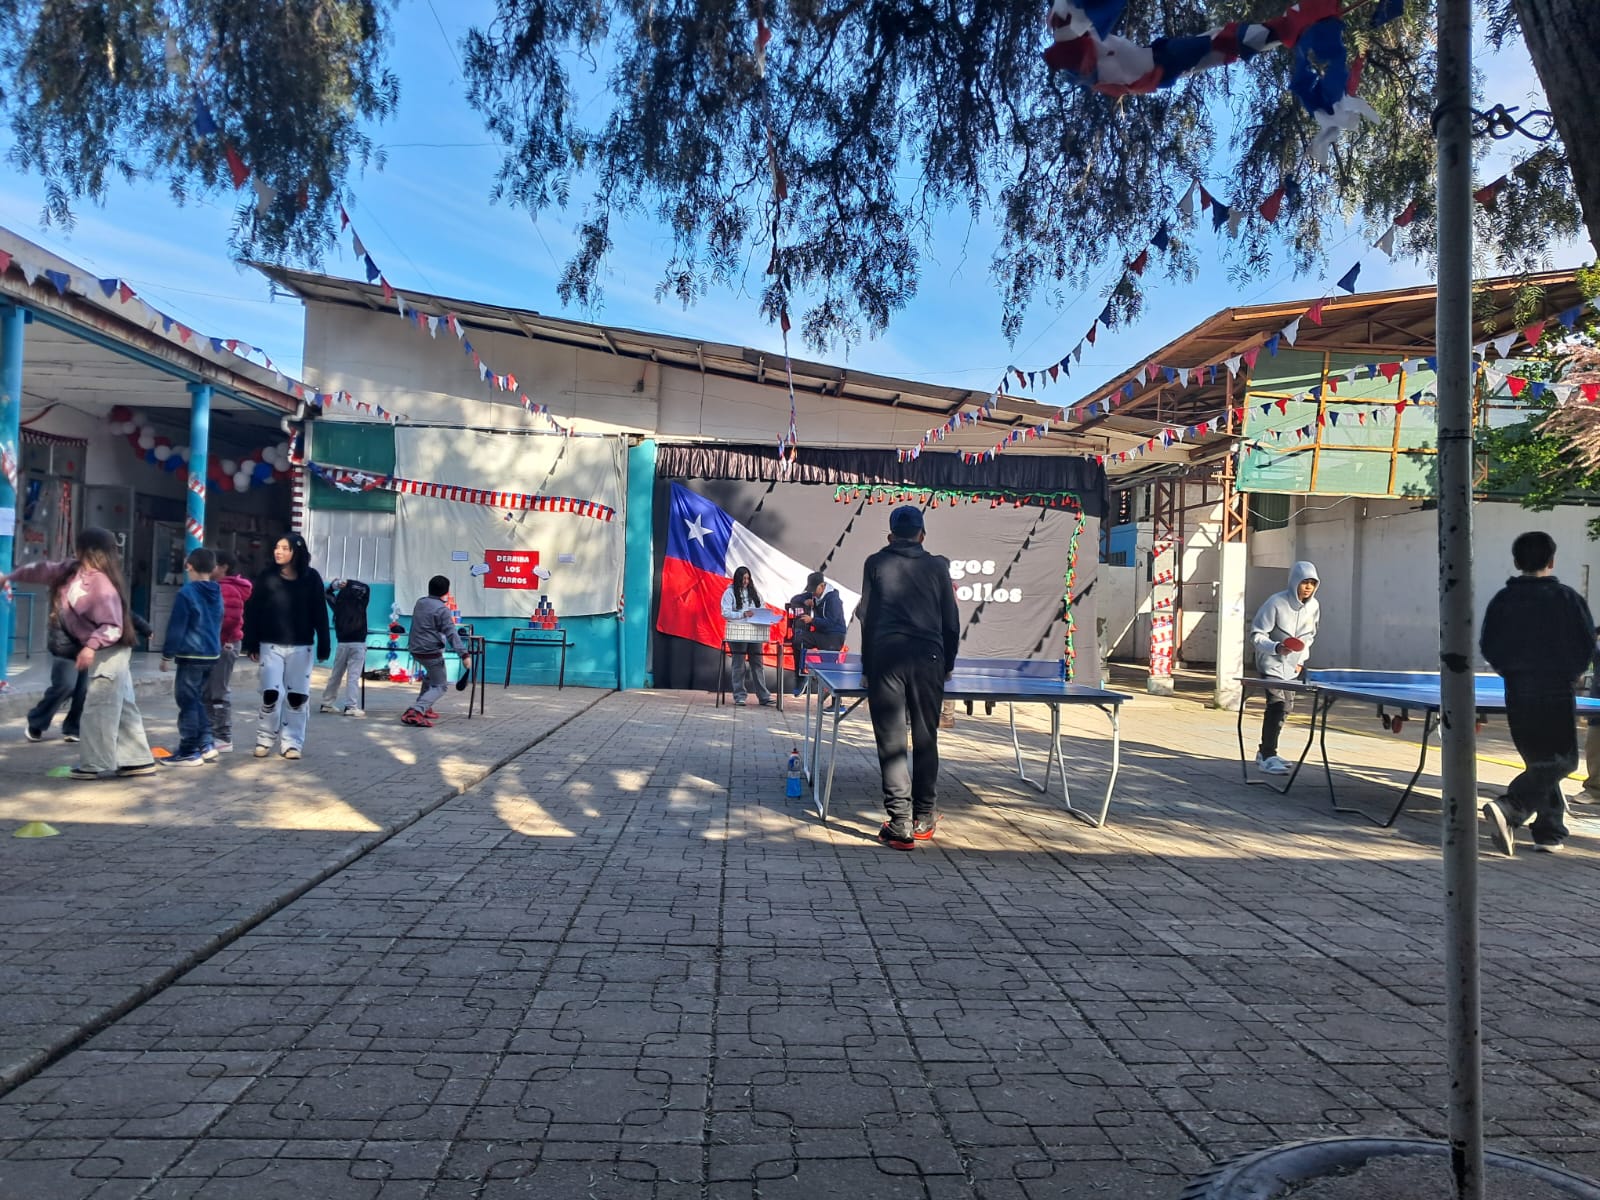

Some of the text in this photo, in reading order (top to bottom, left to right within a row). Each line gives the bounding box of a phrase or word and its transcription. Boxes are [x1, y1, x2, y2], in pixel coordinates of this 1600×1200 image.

[505, 565, 521, 573] LOS
[949, 560, 996, 580] gos
[497, 576, 527, 584] TARROS
[956, 582, 1023, 603] ollos
